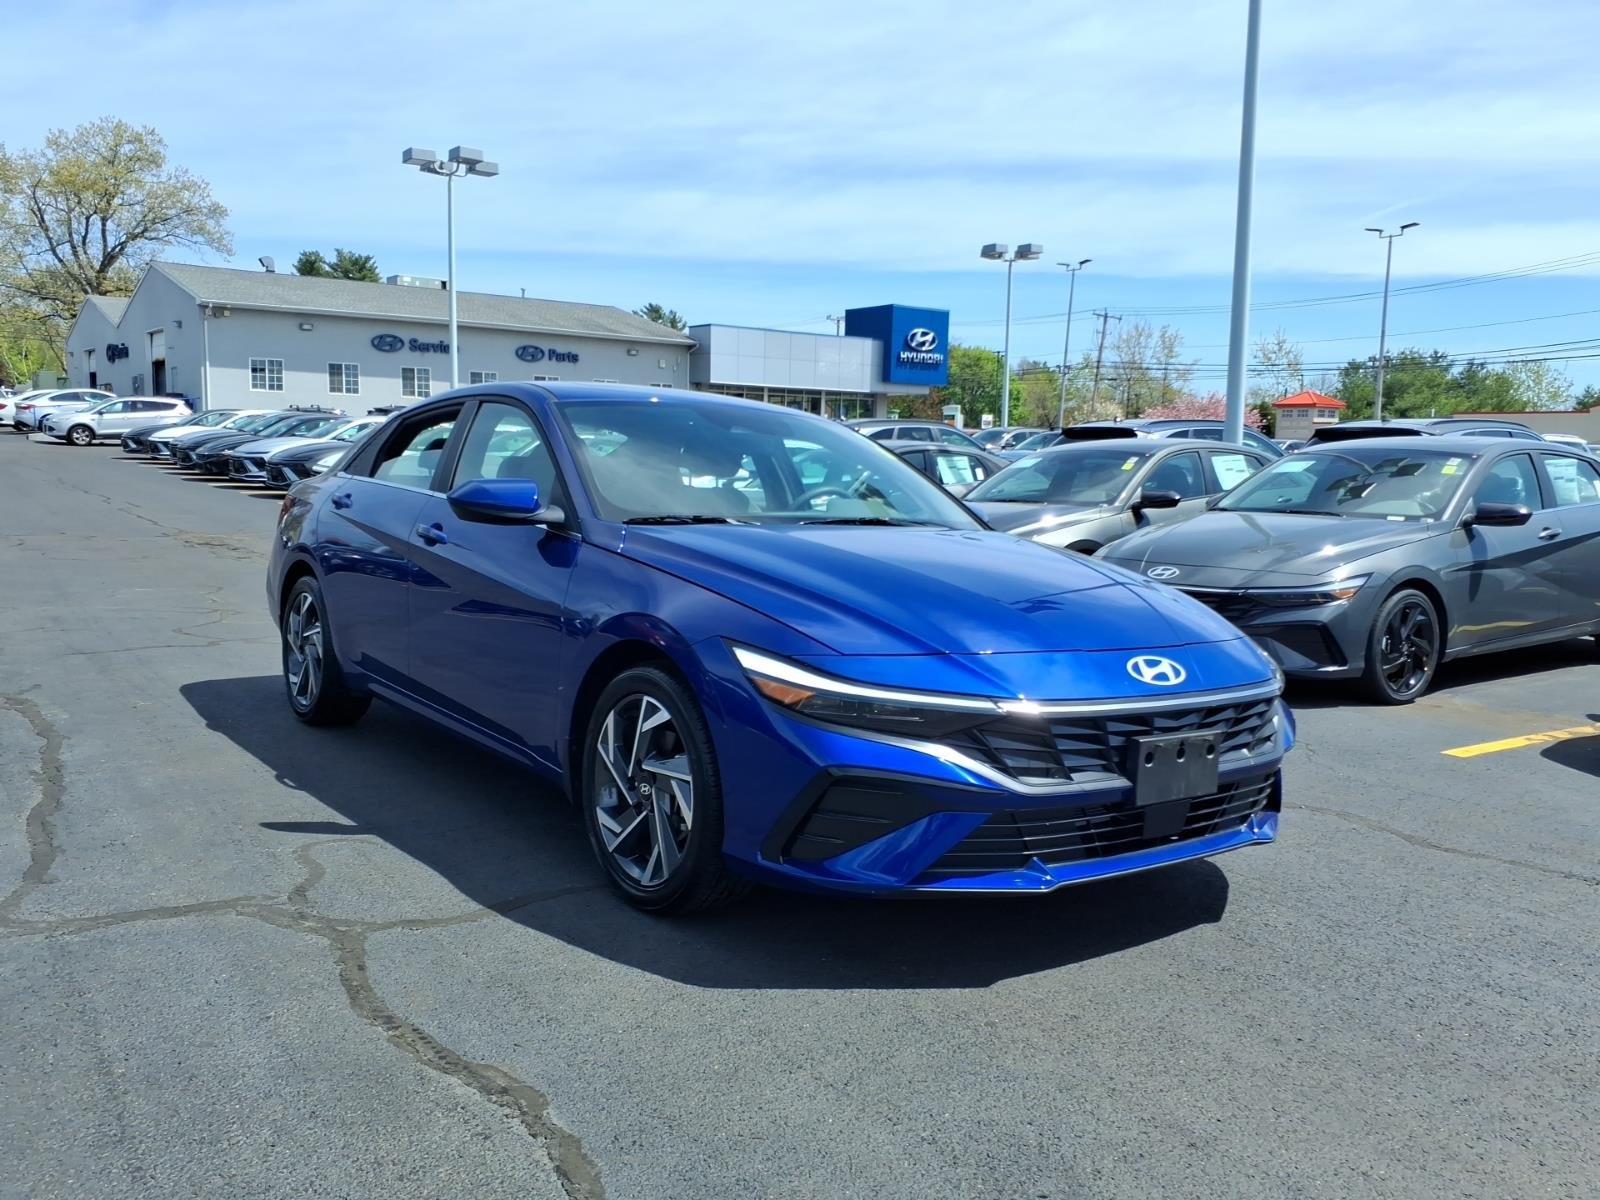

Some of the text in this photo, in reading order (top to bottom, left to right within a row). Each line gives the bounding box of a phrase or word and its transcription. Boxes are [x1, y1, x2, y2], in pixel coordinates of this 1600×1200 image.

[409, 338, 459, 353] Servic
[548, 349, 579, 363] Parts
[900, 351, 944, 364] HYUNDAI
